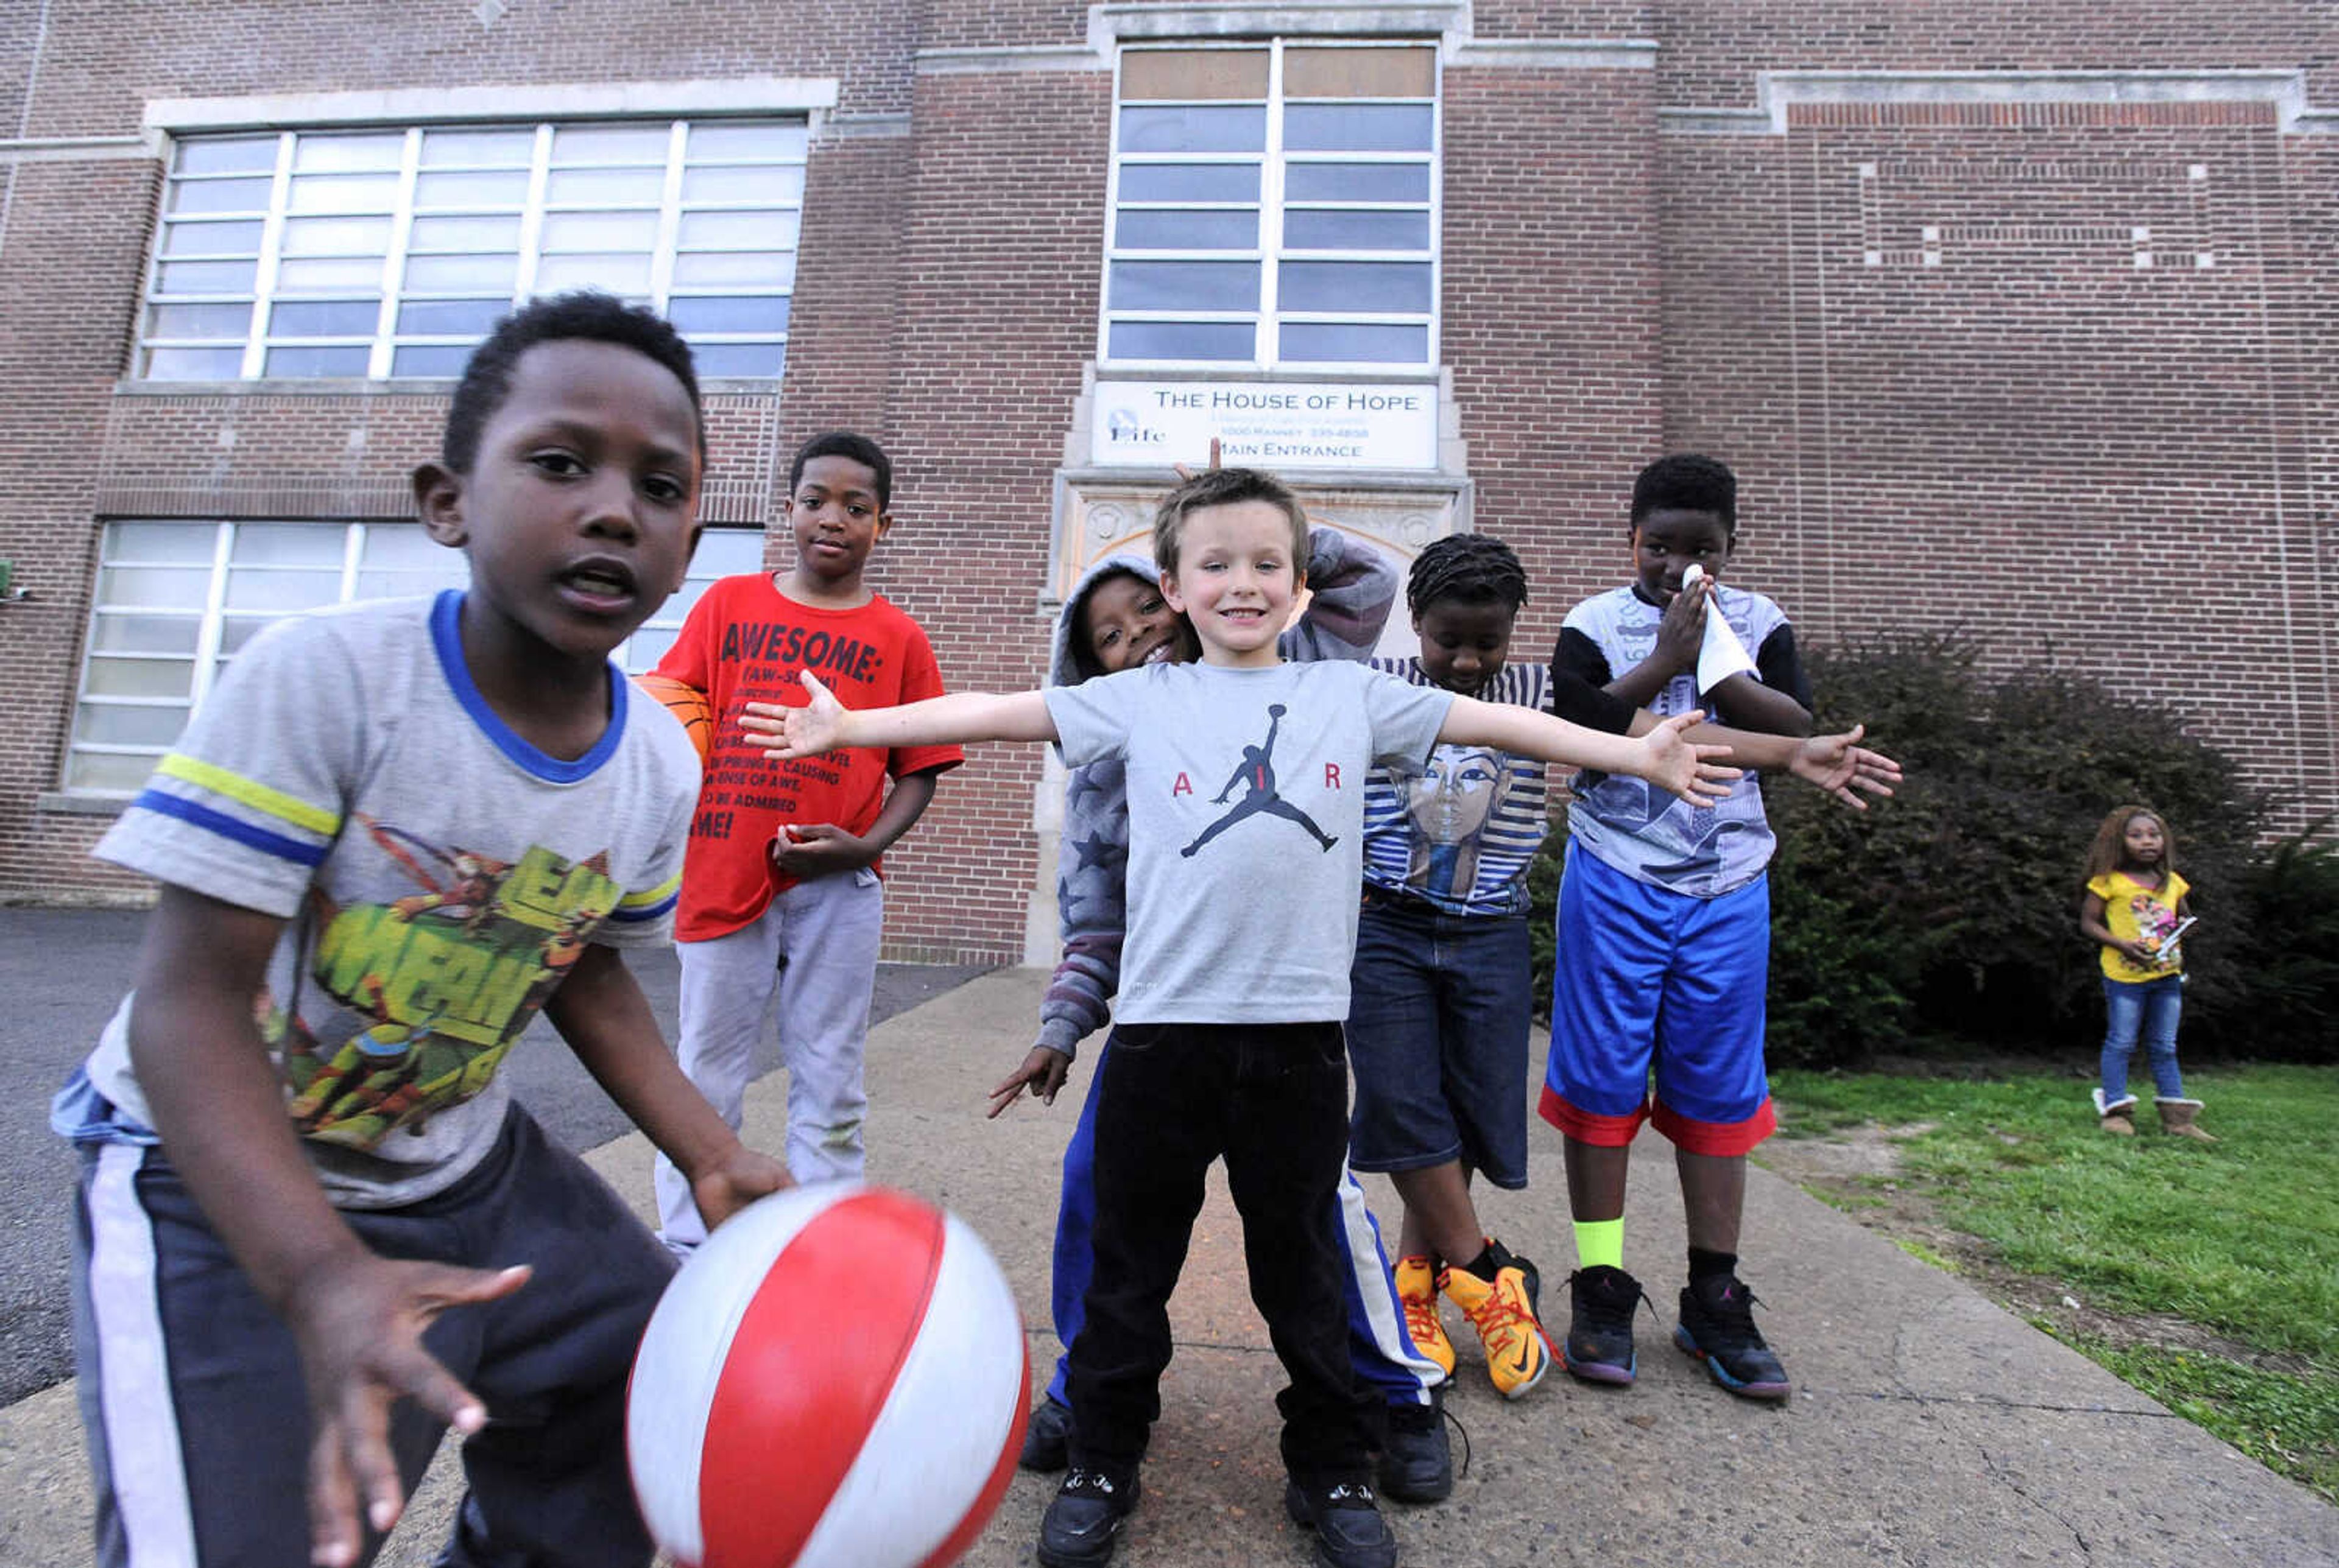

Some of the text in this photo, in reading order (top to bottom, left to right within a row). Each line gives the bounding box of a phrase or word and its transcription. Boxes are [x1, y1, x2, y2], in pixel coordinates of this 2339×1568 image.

[1154, 391, 1419, 411] THE HOUSE OF HOPE
[1264, 442, 1363, 457] ENTRANCE
[783, 758, 841, 786] CAUSING
[734, 793, 797, 813] ADMIRED
